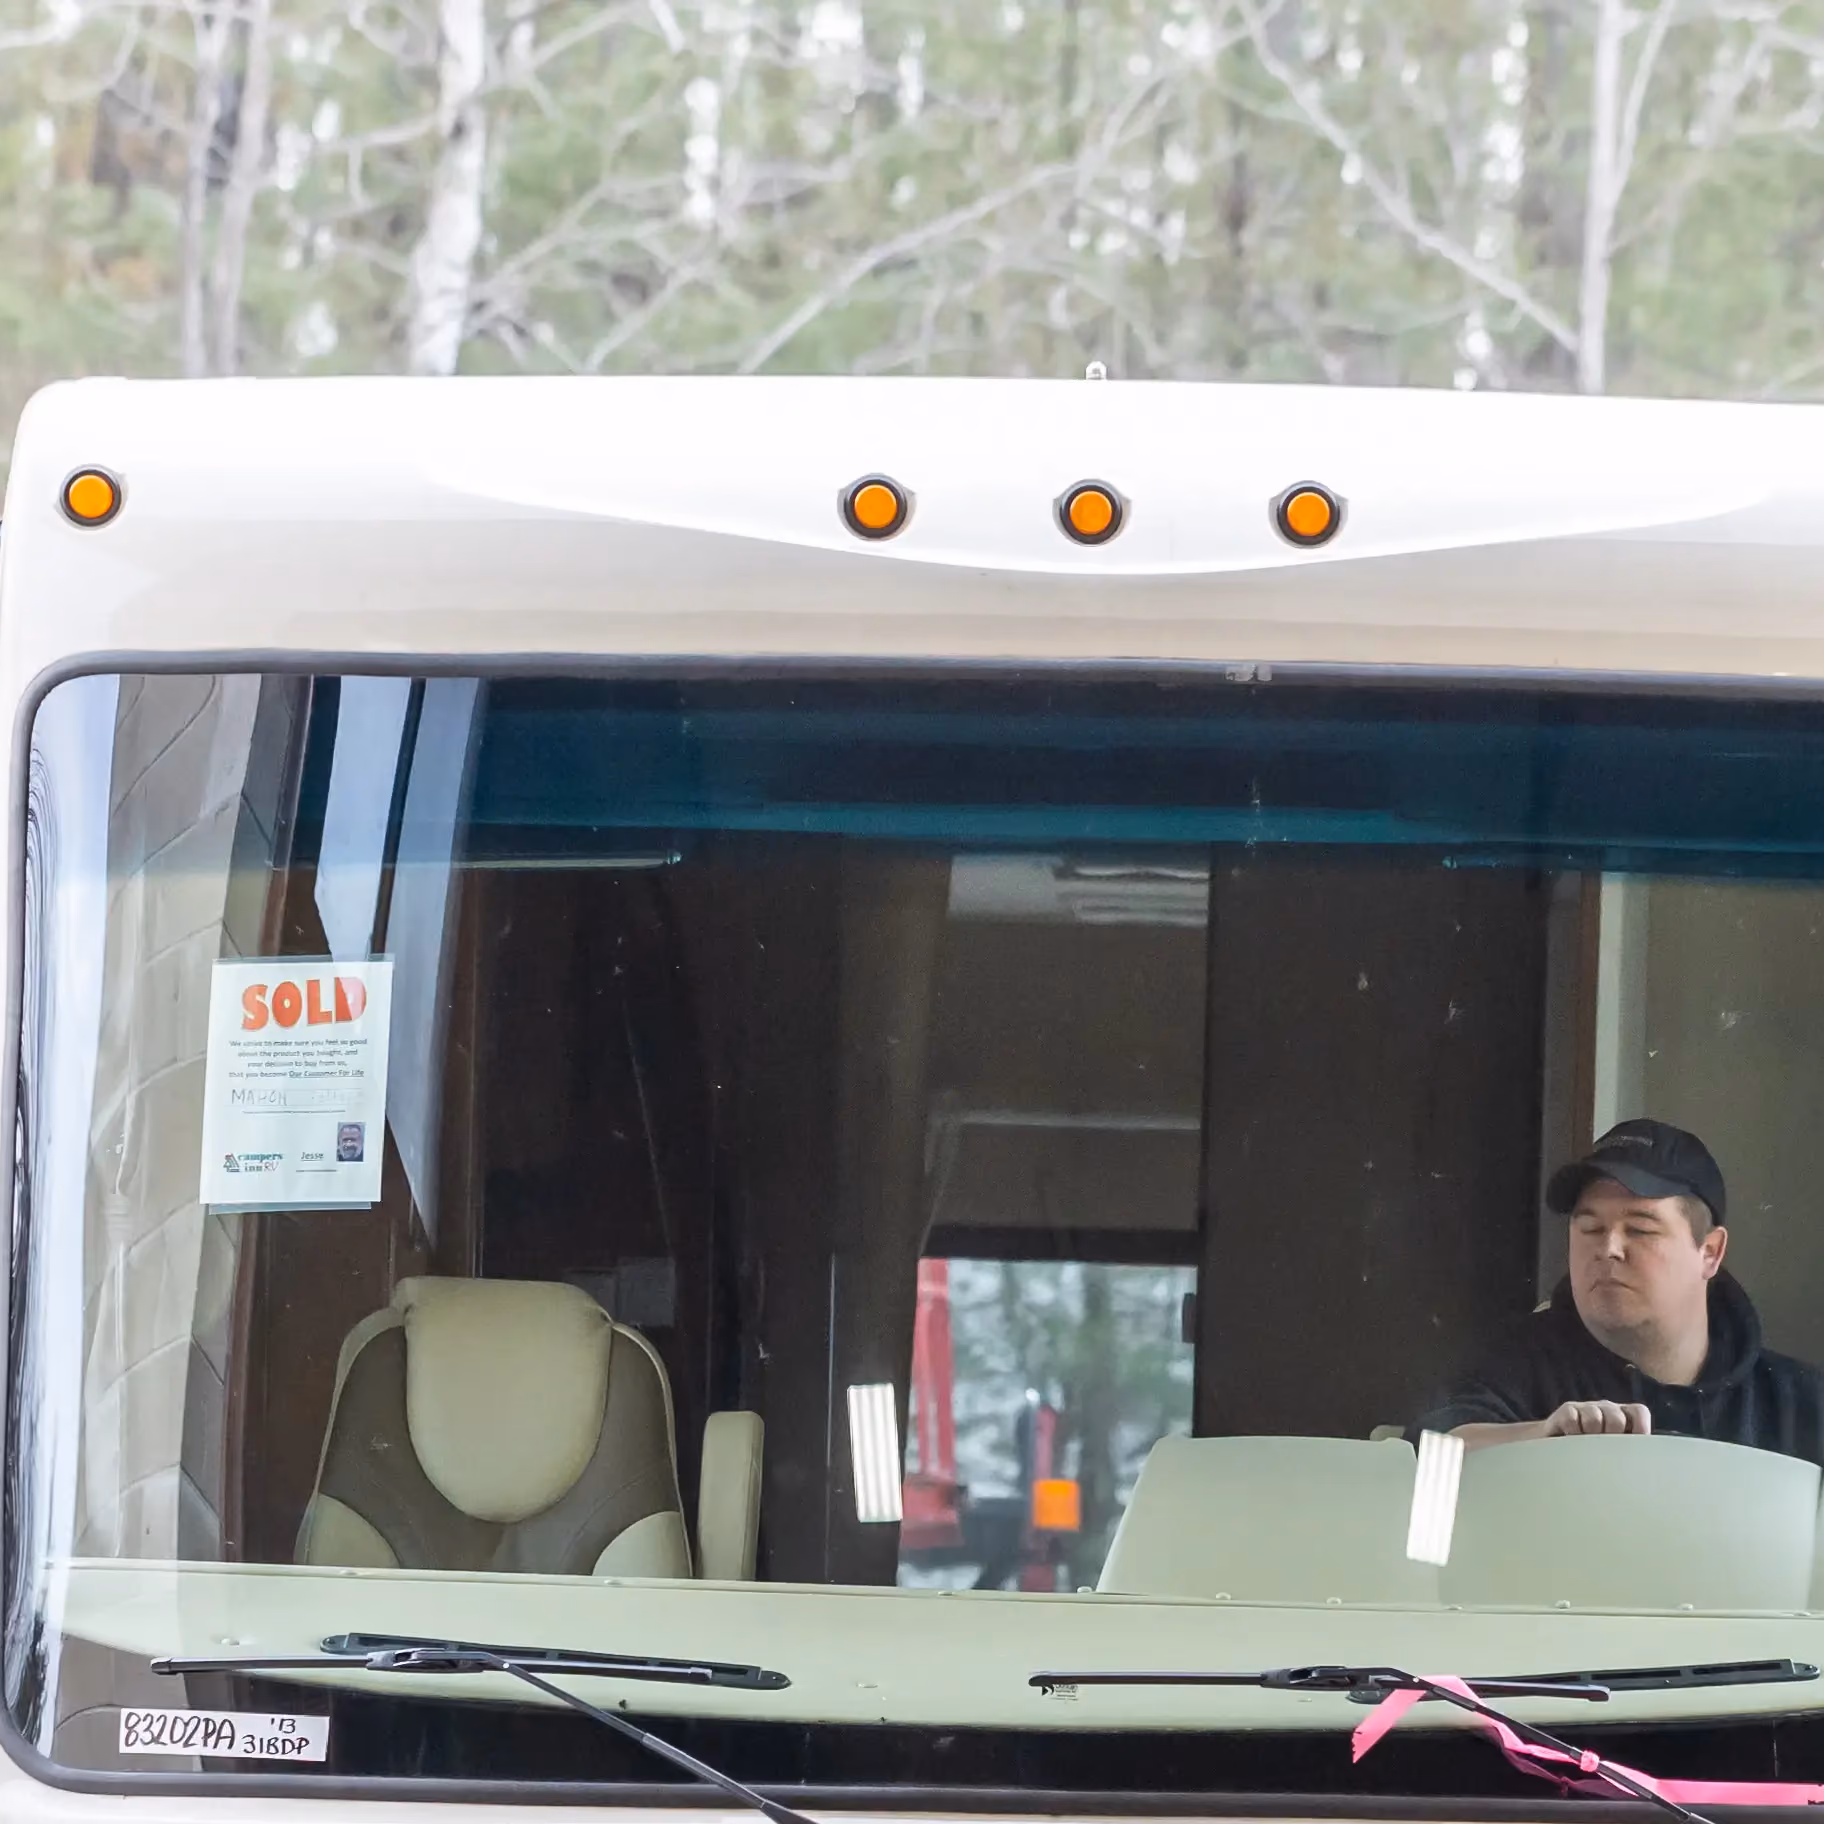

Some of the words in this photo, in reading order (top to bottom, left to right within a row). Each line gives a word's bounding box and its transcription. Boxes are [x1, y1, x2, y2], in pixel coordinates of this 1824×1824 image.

[241, 976, 367, 1032] SOLD
[311, 1040, 324, 1048] you
[350, 1039, 368, 1047] good
[273, 1050, 301, 1058] product
[304, 1060, 317, 1068] buy
[304, 1070, 338, 1078] Customer
[352, 1069, 364, 1077] Life
[237, 1153, 283, 1162] campers
[301, 1152, 324, 1160] Jesse
[244, 1163, 263, 1172] inn
[264, 1162, 279, 1172] RV
[124, 1711, 236, 1750] 83202PA
